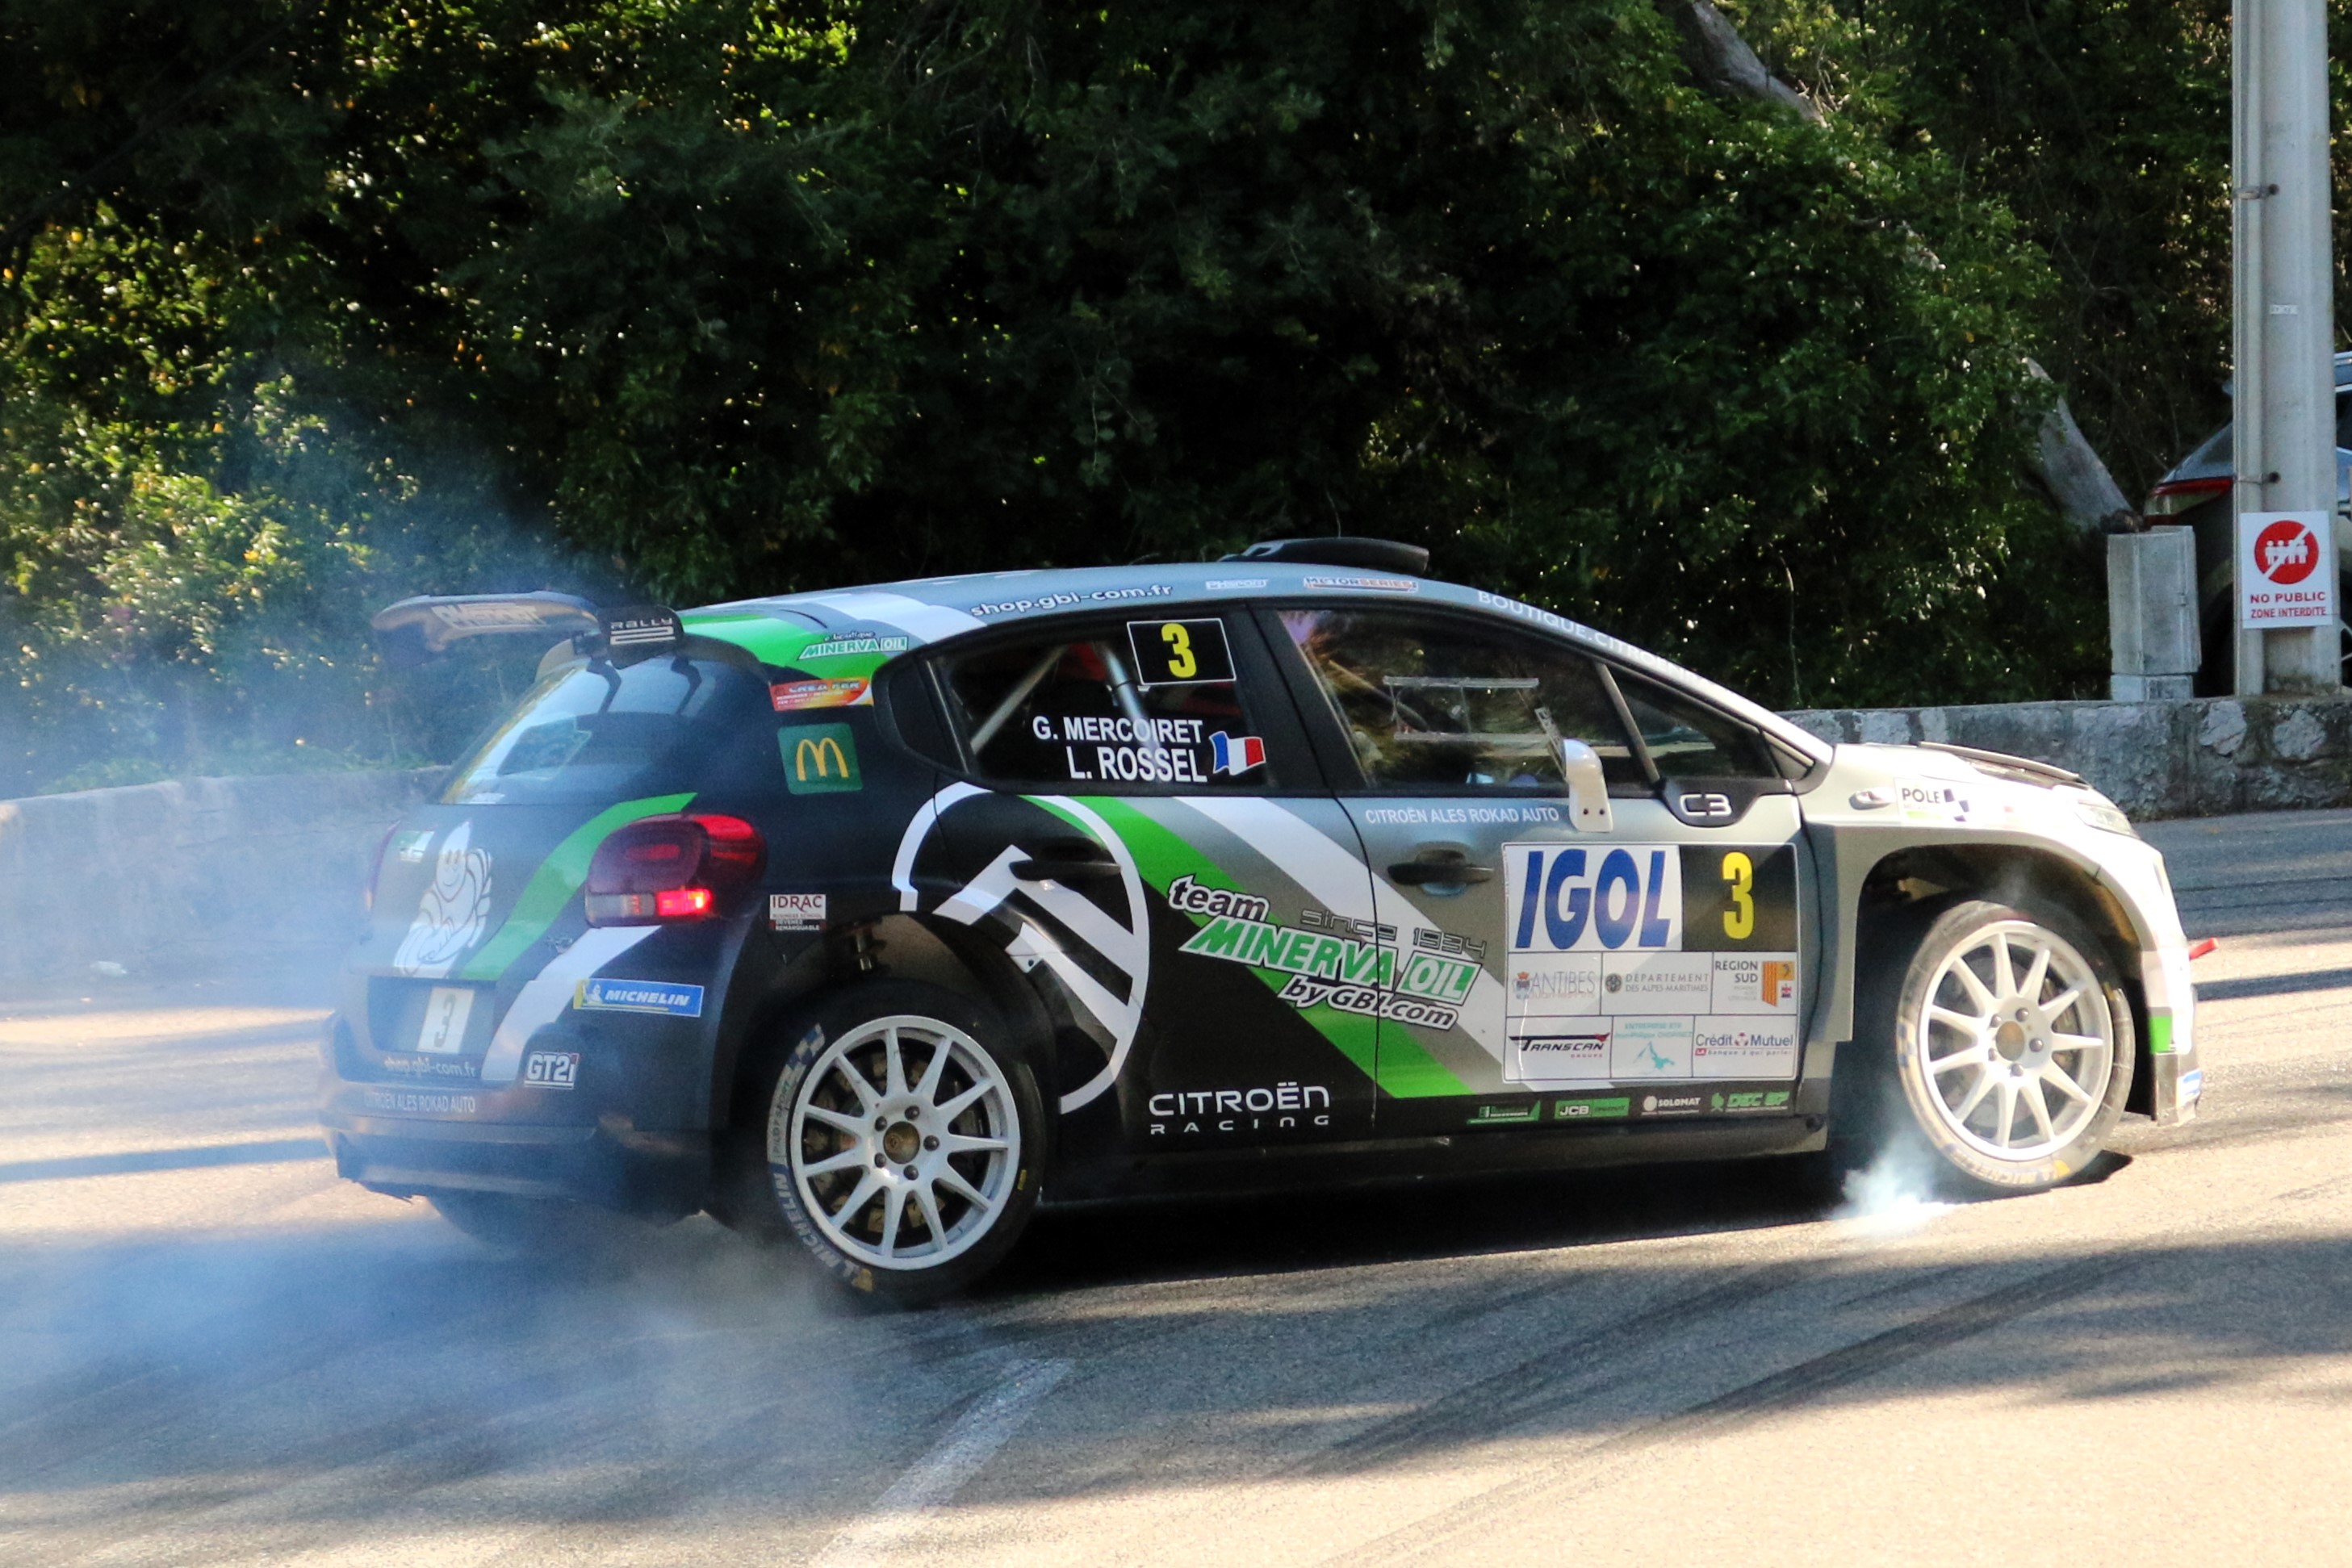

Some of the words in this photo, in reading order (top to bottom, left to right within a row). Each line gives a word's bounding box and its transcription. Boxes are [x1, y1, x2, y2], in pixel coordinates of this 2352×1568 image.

[2250, 594, 2270, 604] NO
[2275, 592, 2325, 603] PUBLIC
[611, 618, 673, 629] RALLY
[2251, 608, 2275, 618] ZONE
[2279, 607, 2326, 617] INTERDITE
[797, 638, 880, 660] MINERVA
[881, 638, 907, 651] OIL
[1161, 622, 1197, 678] 3
[1032, 716, 1058, 740] G.
[1063, 717, 1203, 743] MERCOIRET
[1066, 746, 1092, 780] L.
[1097, 746, 1207, 783] ROSSEL
[1679, 793, 1732, 817] C3
[1902, 788, 1940, 804] POLE
[1366, 806, 1428, 824] CITROËN
[1430, 809, 1467, 823] ALES
[1470, 809, 1519, 823] ROKAD
[1522, 808, 1559, 822] AUTO
[772, 896, 822, 914] IDRAC
[1170, 876, 1269, 922] team
[1515, 848, 1671, 950] IGOL
[1722, 851, 1755, 939] 3
[1301, 910, 1396, 941] since
[1413, 927, 1487, 958] 1934
[1179, 916, 1398, 992] MINERVA
[1402, 953, 1477, 1002] OIL
[1534, 971, 1596, 994] ANTIBES
[1626, 985, 1638, 993] DES
[1735, 973, 1758, 983] SUD
[605, 989, 690, 1006] MICHELIN
[434, 993, 457, 1047] 3
[1696, 1034, 1732, 1046] Crédit
[1751, 1035, 1793, 1046] Mutuel
[526, 1052, 580, 1082] GT2i
[396, 1094, 417, 1111] ALES
[419, 1095, 449, 1112] ROKAD
[451, 1095, 475, 1113] AUTO
[1149, 1081, 1330, 1116] CITROËN
[1658, 1098, 1701, 1107] SOLOMAT
[1559, 1105, 1589, 1116] JCB
[1150, 1115, 1330, 1135] RACING
[772, 1173, 842, 1269] MICHELIN
